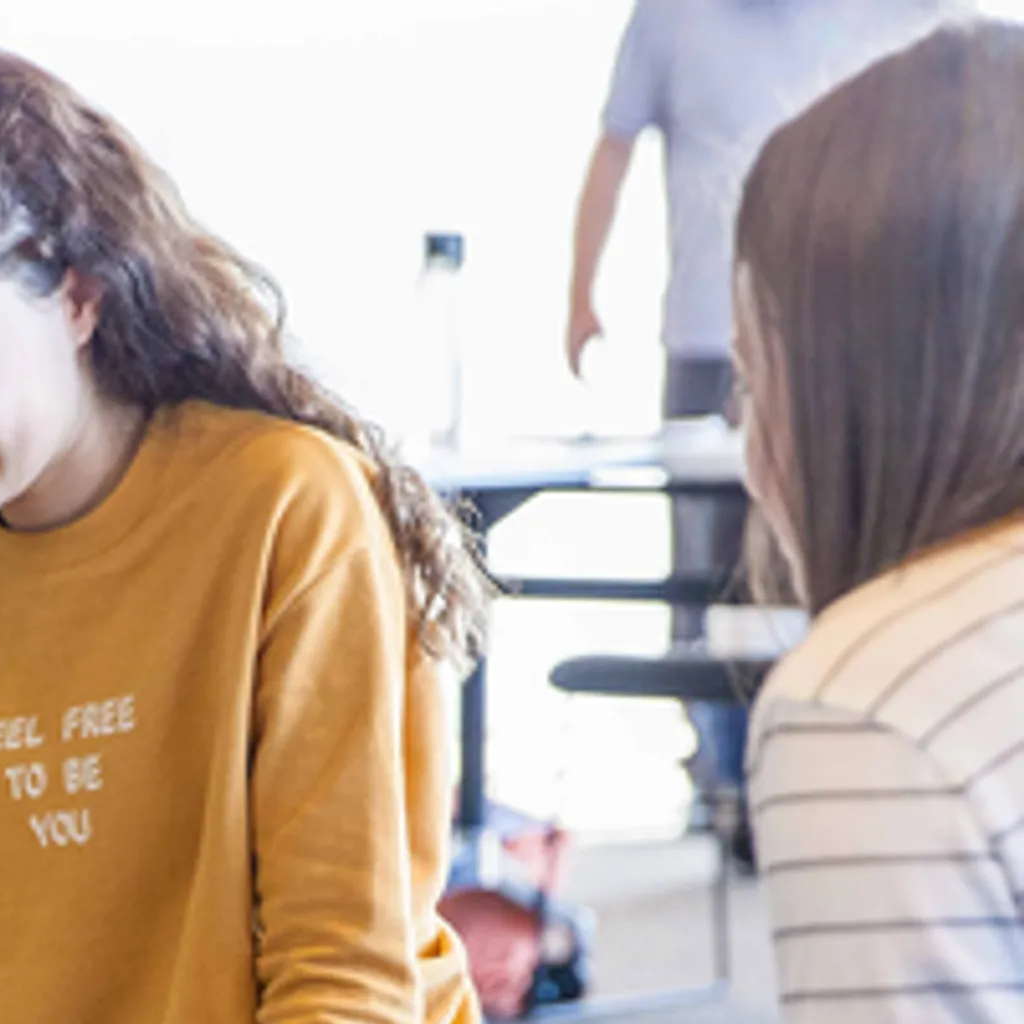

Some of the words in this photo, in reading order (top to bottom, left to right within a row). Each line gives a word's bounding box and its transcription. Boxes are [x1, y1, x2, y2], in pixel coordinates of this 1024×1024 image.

[61, 695, 136, 741] FREE
[5, 762, 47, 800] TO
[62, 754, 103, 794] BE
[29, 808, 91, 848] YOU
